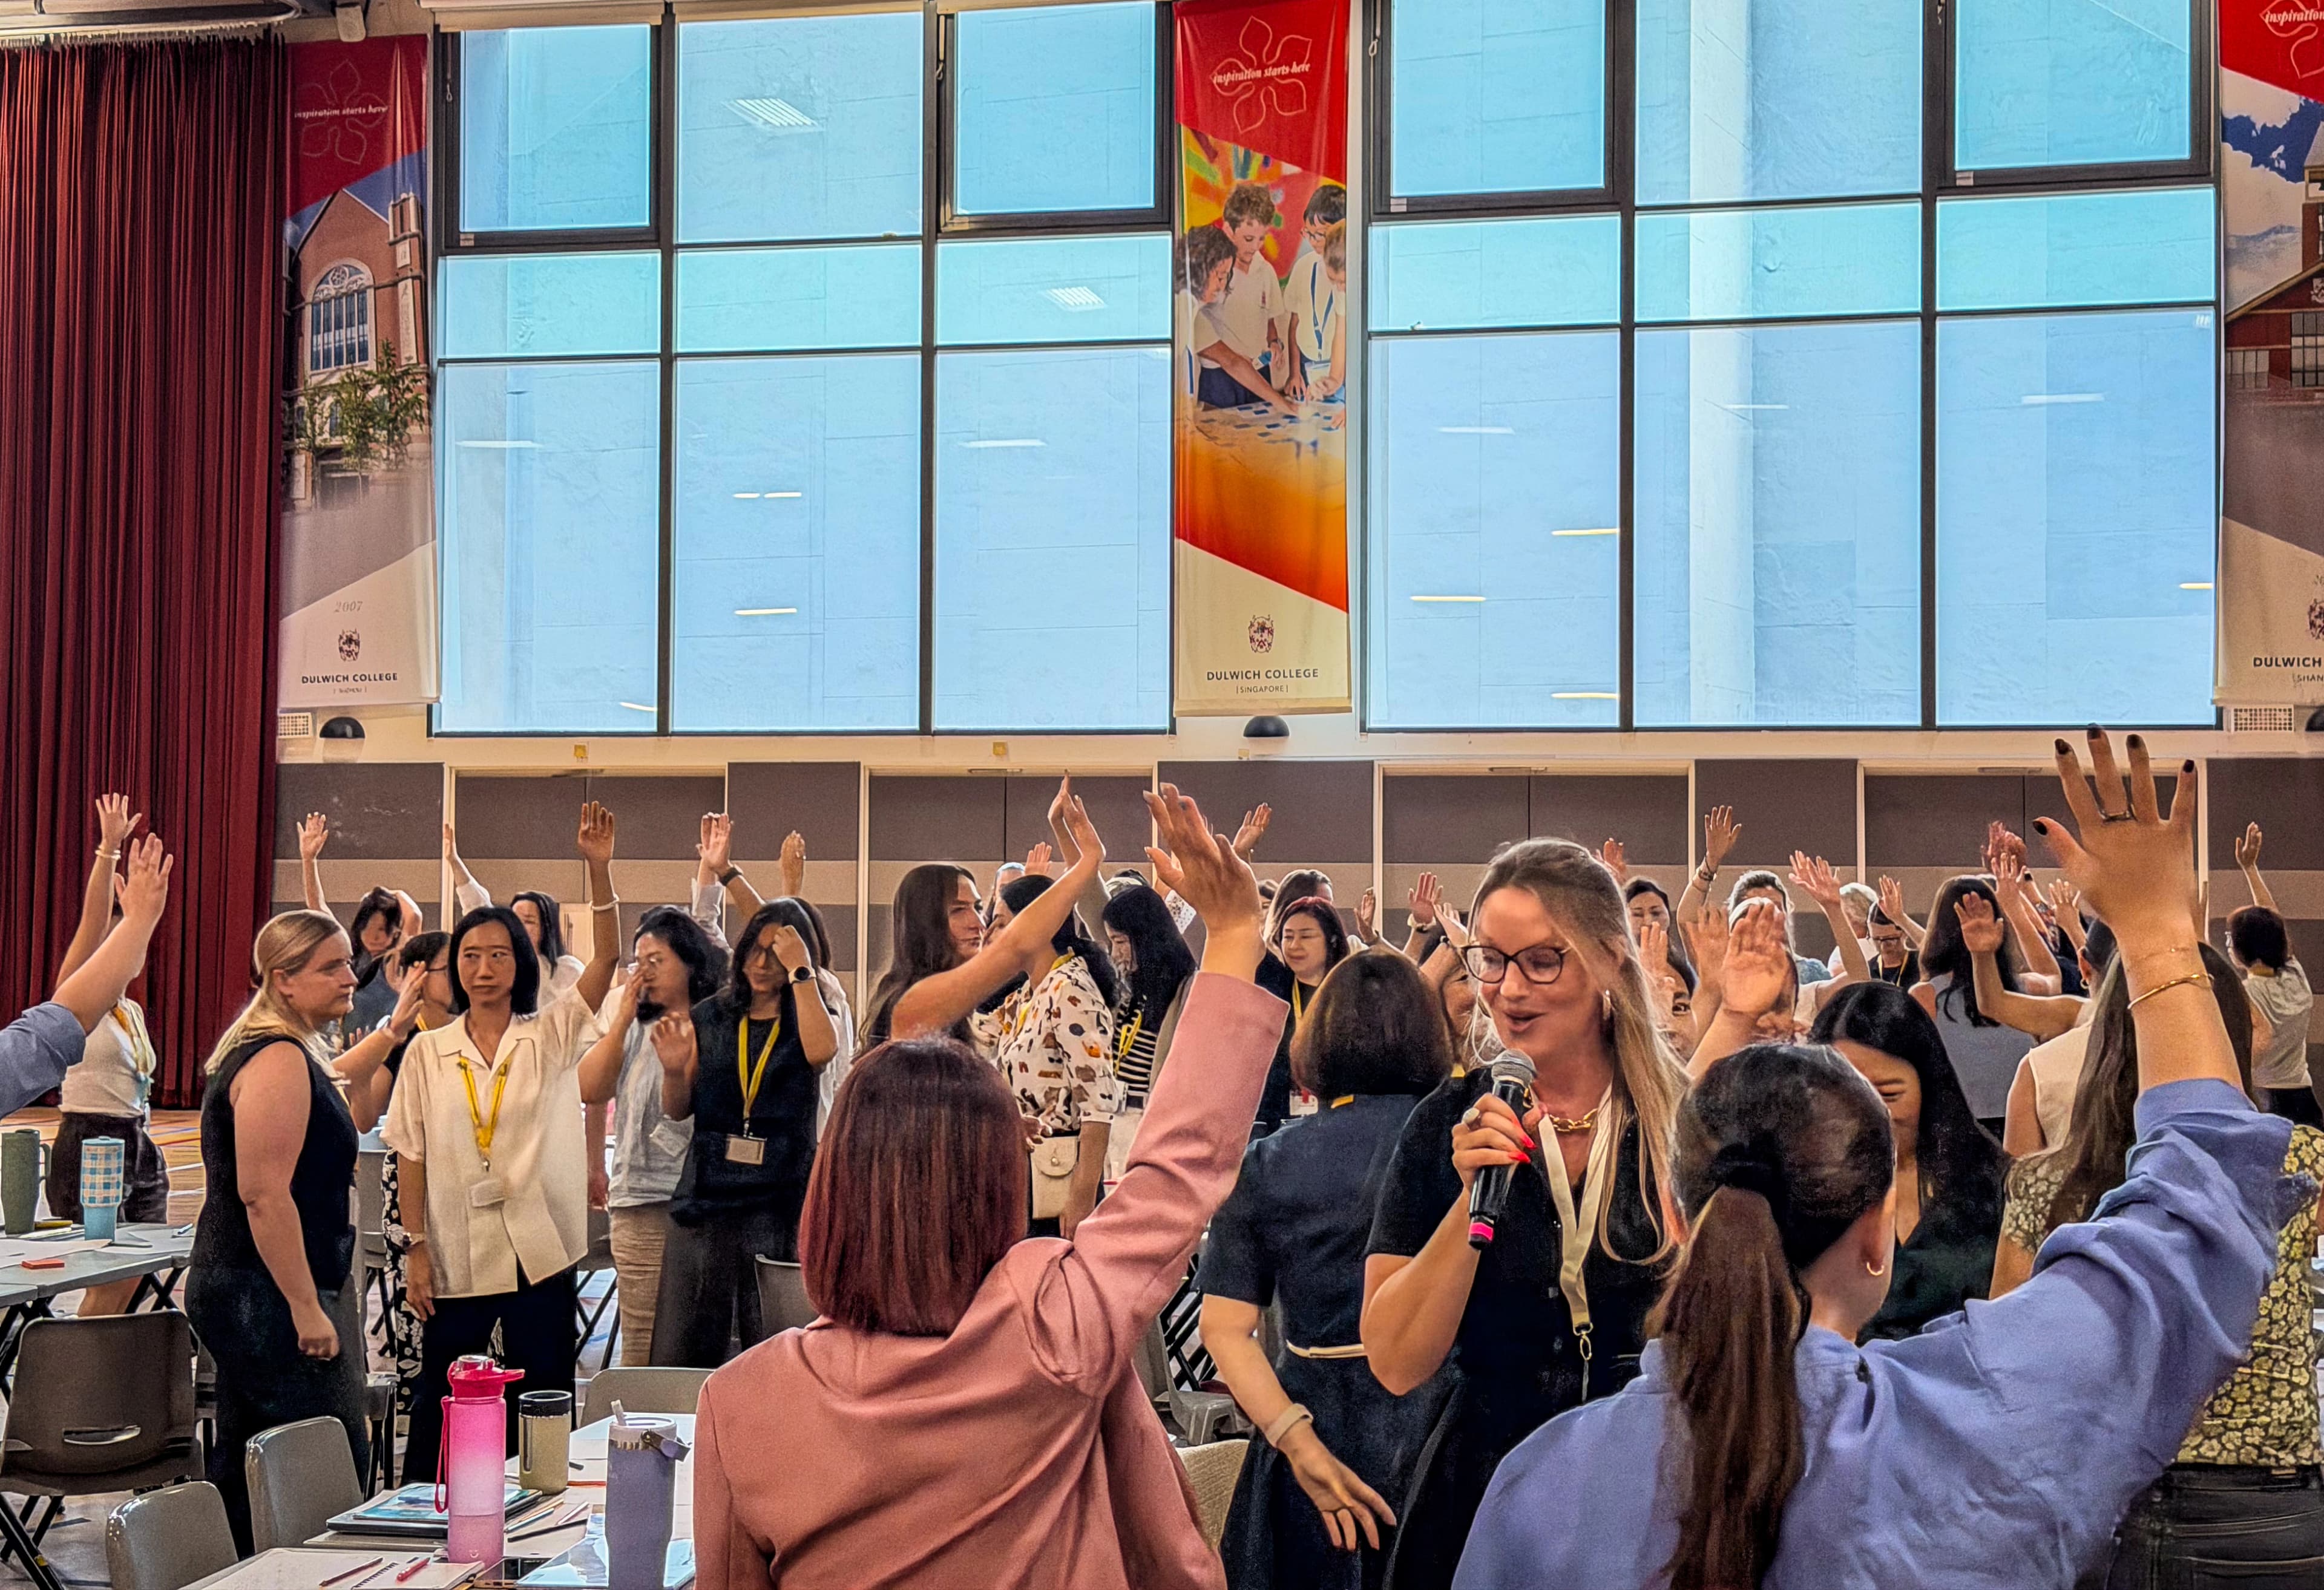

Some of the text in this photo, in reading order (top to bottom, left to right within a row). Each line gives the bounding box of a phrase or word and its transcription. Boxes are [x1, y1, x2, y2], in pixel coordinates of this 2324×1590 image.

[2265, 8, 2324, 26] inspiration
[1213, 61, 1310, 87] inspiration starts here
[294, 104, 389, 119] inspiration starts here
[333, 600, 363, 613] 2007
[2253, 656, 2322, 667] DULWICH
[301, 672, 398, 684] DULWICH COLLEGE
[1207, 668, 1319, 681] DULWICH COLLEGE
